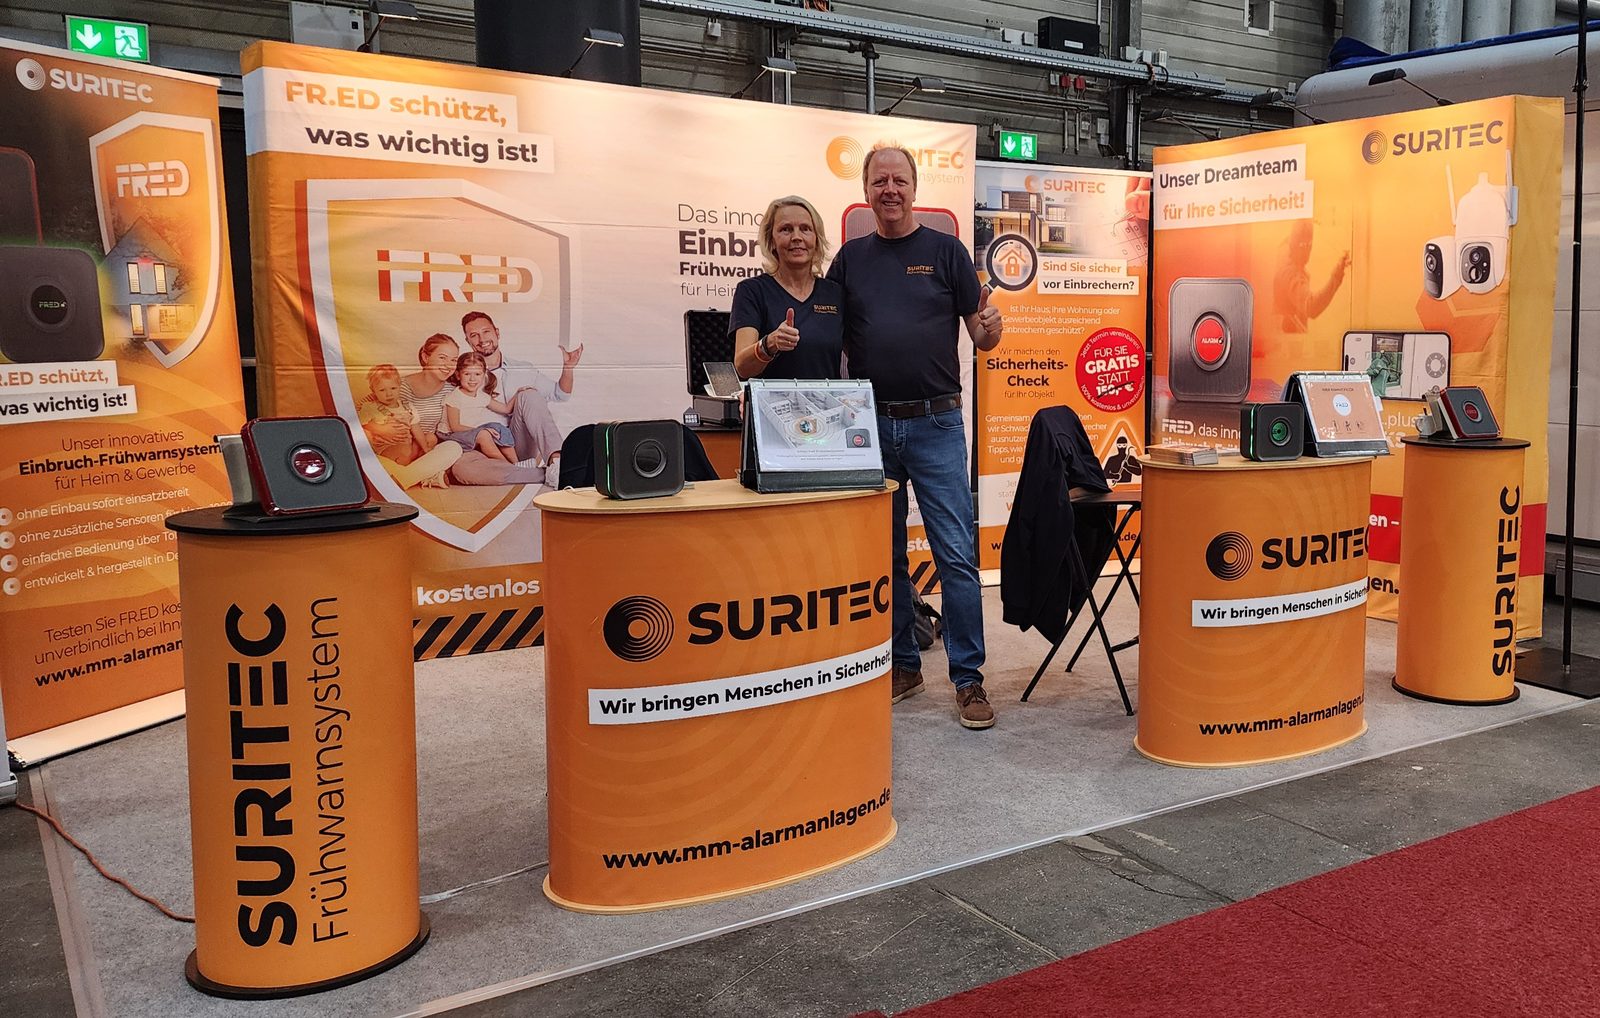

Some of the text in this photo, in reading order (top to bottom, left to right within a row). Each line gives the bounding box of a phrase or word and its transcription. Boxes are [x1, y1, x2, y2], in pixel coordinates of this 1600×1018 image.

[50, 68, 154, 103] SURITEC
[285, 81, 507, 127] FR.ED schützt,
[305, 127, 538, 163] was wichtig ist!
[1392, 120, 1503, 156] SURITEC
[115, 160, 190, 197] FRED
[1044, 179, 1106, 193] SURITEC
[1159, 158, 1298, 189] Unser Dreamteam
[678, 203, 718, 224] Das
[1163, 192, 1305, 221] für Ihre Sicherheit!
[377, 249, 543, 303] FRED
[1043, 260, 1121, 273] Sind Sie sicher
[680, 282, 701, 296] für
[1043, 279, 1135, 290] vor Einbrechern?
[1002, 315, 1057, 325] Gewerbeobjekt
[1010, 305, 1019, 313] Ist
[1020, 305, 1031, 313] Ihr
[1066, 306, 1103, 315] Wohnung
[999, 347, 1011, 355] Wir
[1045, 347, 1061, 355] den
[1089, 331, 1109, 344] Termin
[987, 357, 1068, 370] Sicherheits-
[1085, 354, 1139, 374] GRATIS
[1094, 345, 1128, 358] FÜR SIE
[0, 369, 109, 387] .ED schützt,
[1007, 374, 1050, 386] Check
[1097, 370, 1130, 385] STATT
[33, 394, 99, 412] wichtig
[103, 393, 128, 407] ist!
[1004, 390, 1055, 399] für Ihr Objekt!
[985, 414, 1030, 422] Gemeinsam
[1198, 423, 1218, 437] das
[61, 430, 185, 452] Unser innovatives
[987, 445, 1010, 454] Tipps,
[19, 444, 222, 475] Einbruch-Frühwarnsystem
[1000, 455, 1014, 463] und
[55, 462, 196, 490] für Heim & Gewerbe
[17, 487, 190, 520] ohne Einbau sofort einsatzbereit
[19, 512, 164, 544] ohne zusätzliche Sensoren
[22, 548, 72, 566] einfache
[74, 540, 134, 559] Bedienung
[136, 534, 161, 547] über
[24, 570, 84, 589] entwickelt
[87, 567, 95, 577] &
[97, 556, 152, 577] hergestellt
[154, 553, 164, 563] in
[1492, 485, 1520, 677] SURITEC
[416, 578, 540, 606] kostenlos
[687, 575, 890, 645] SURITEC
[1201, 608, 1227, 619] Wir
[1230, 605, 1279, 620] bringen
[1282, 596, 1333, 614] Menschen
[1335, 593, 1342, 604] in
[44, 623, 93, 643] Testen
[95, 616, 116, 631] Sie
[119, 605, 159, 626] FR.ED
[34, 631, 134, 665] unverbindlich
[137, 622, 156, 640] bei
[600, 697, 636, 715] Wir
[642, 692, 719, 714] bringen
[725, 674, 814, 703] Menschen
[817, 670, 832, 685] in
[225, 602, 298, 948] SURITEC
[307, 597, 351, 943] Frühwarnsystem
[602, 787, 890, 869] www.mm-alarmanlagen.de
